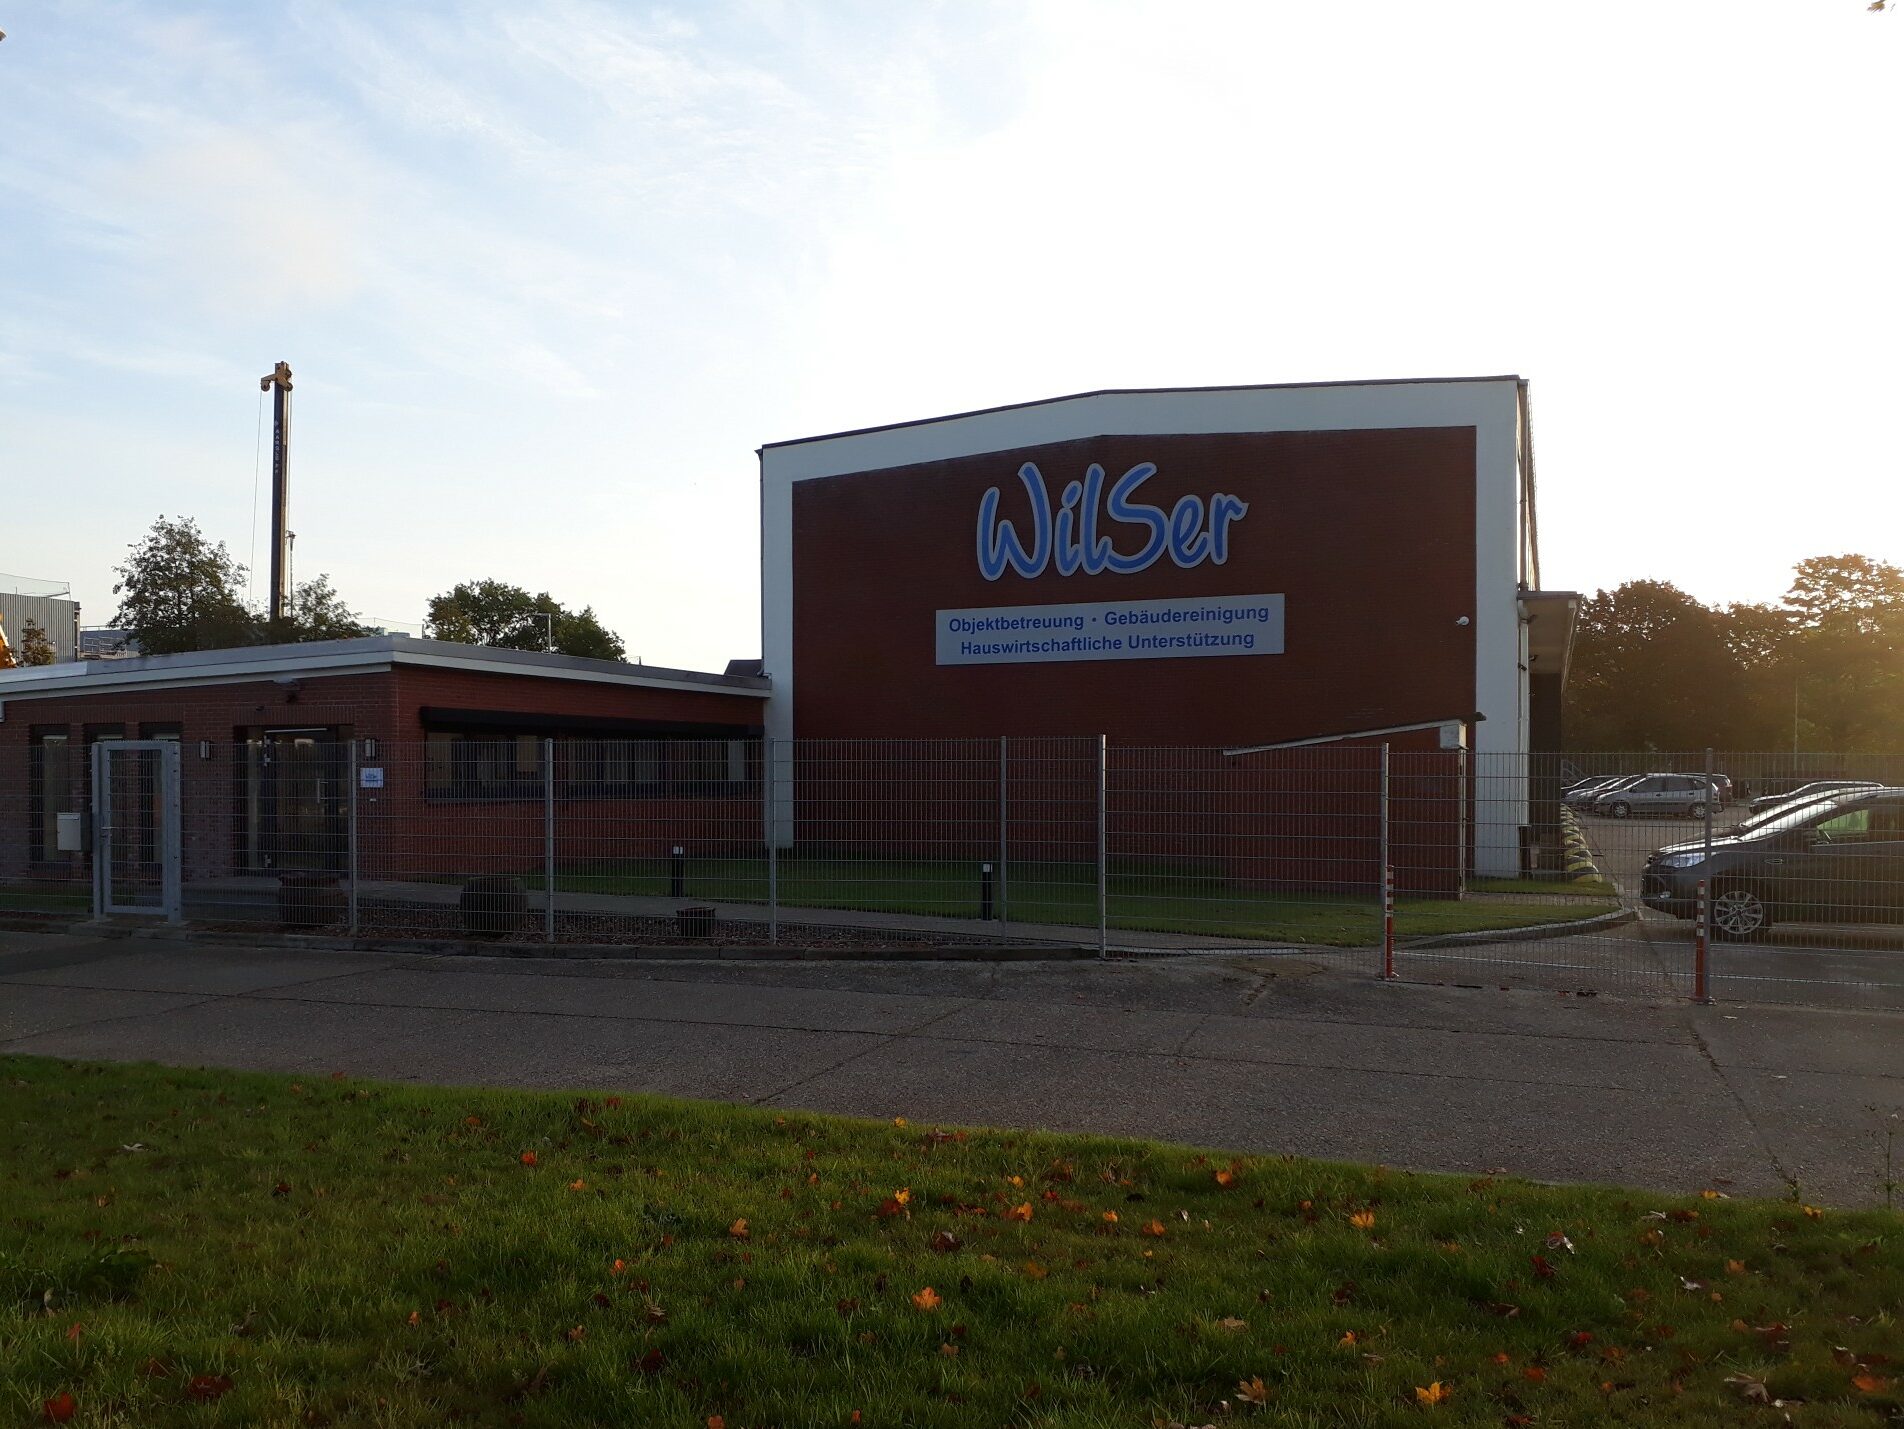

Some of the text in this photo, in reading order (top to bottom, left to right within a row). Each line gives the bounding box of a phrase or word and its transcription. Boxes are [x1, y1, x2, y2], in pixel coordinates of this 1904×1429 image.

[976, 461, 1249, 581] WilSer
[948, 605, 1269, 634] Objektbetreuung Gebäudereinigung
[960, 631, 1255, 655] Hauswirtschaftliche Unterstützung
